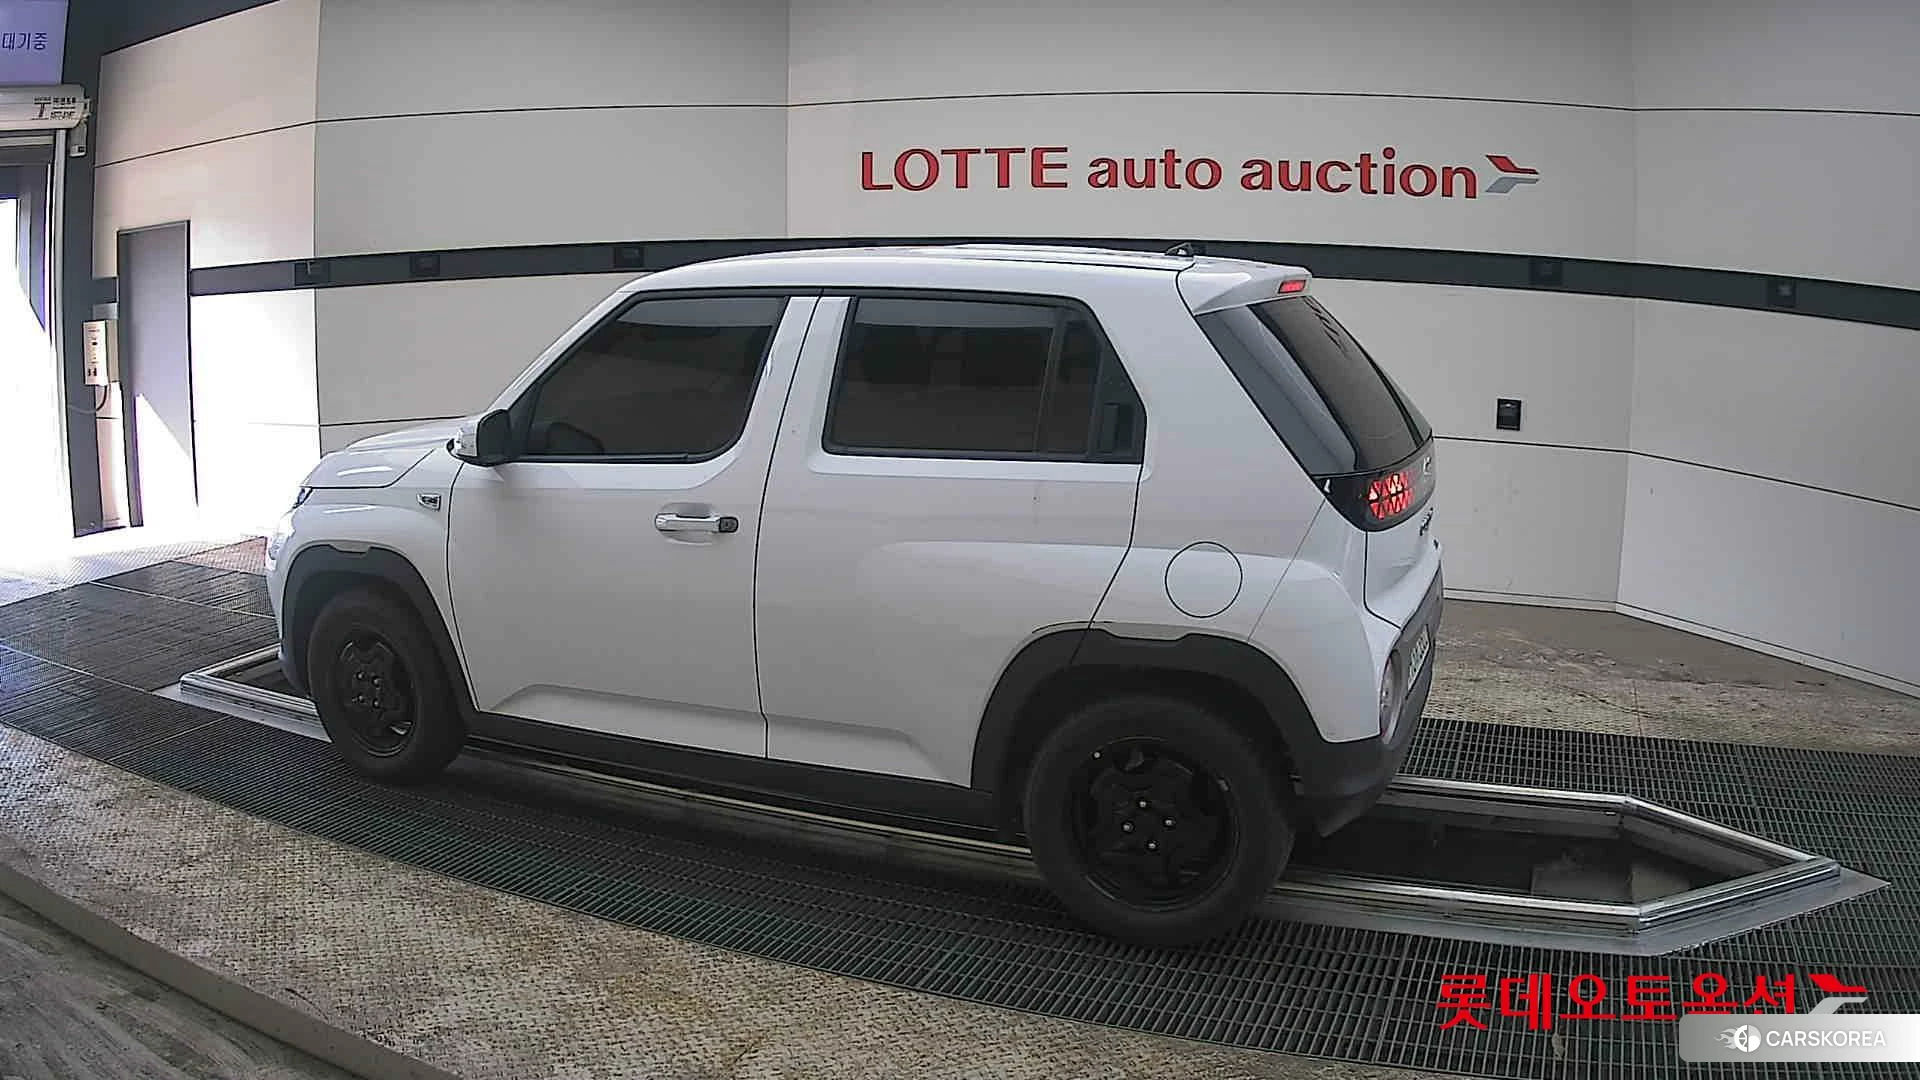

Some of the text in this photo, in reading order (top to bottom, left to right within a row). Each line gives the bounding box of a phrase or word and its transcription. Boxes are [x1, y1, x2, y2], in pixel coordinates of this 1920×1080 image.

[2, 31, 48, 51] 대기중
[860, 146, 1478, 199] LOTTE auto auction
